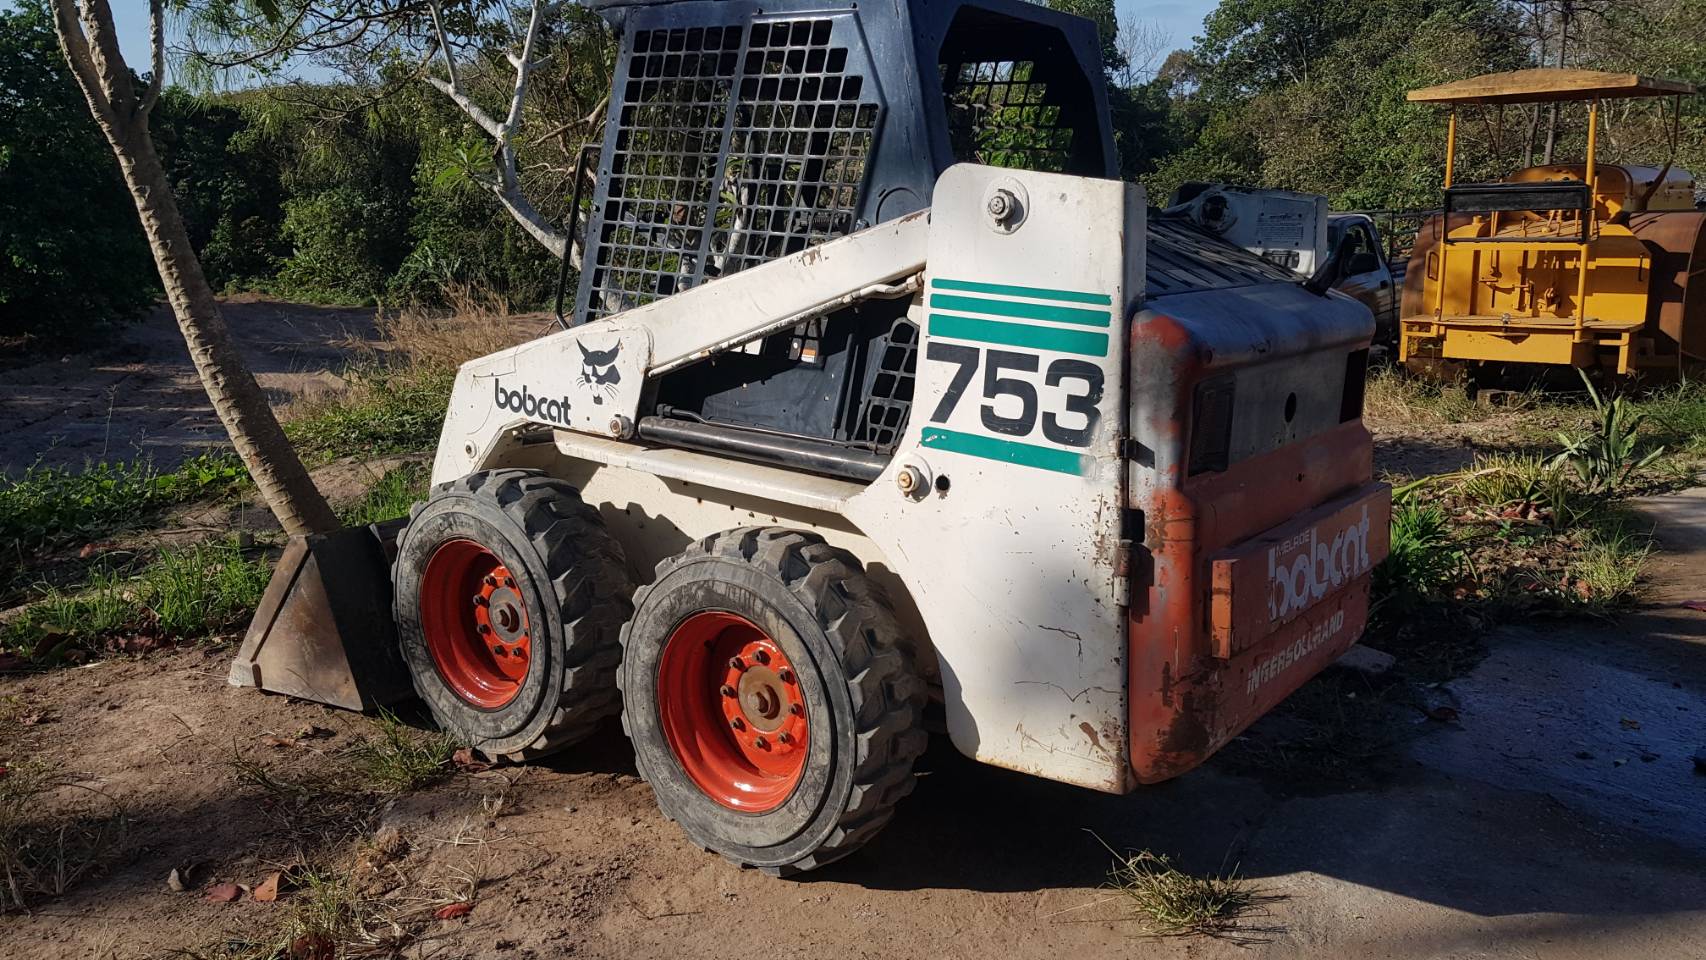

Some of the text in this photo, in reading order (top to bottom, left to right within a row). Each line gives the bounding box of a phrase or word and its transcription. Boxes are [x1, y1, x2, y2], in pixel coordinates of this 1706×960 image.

[494, 378, 571, 425] bobcat
[926, 341, 1105, 448] 753
[1268, 504, 1370, 621] bobcat
